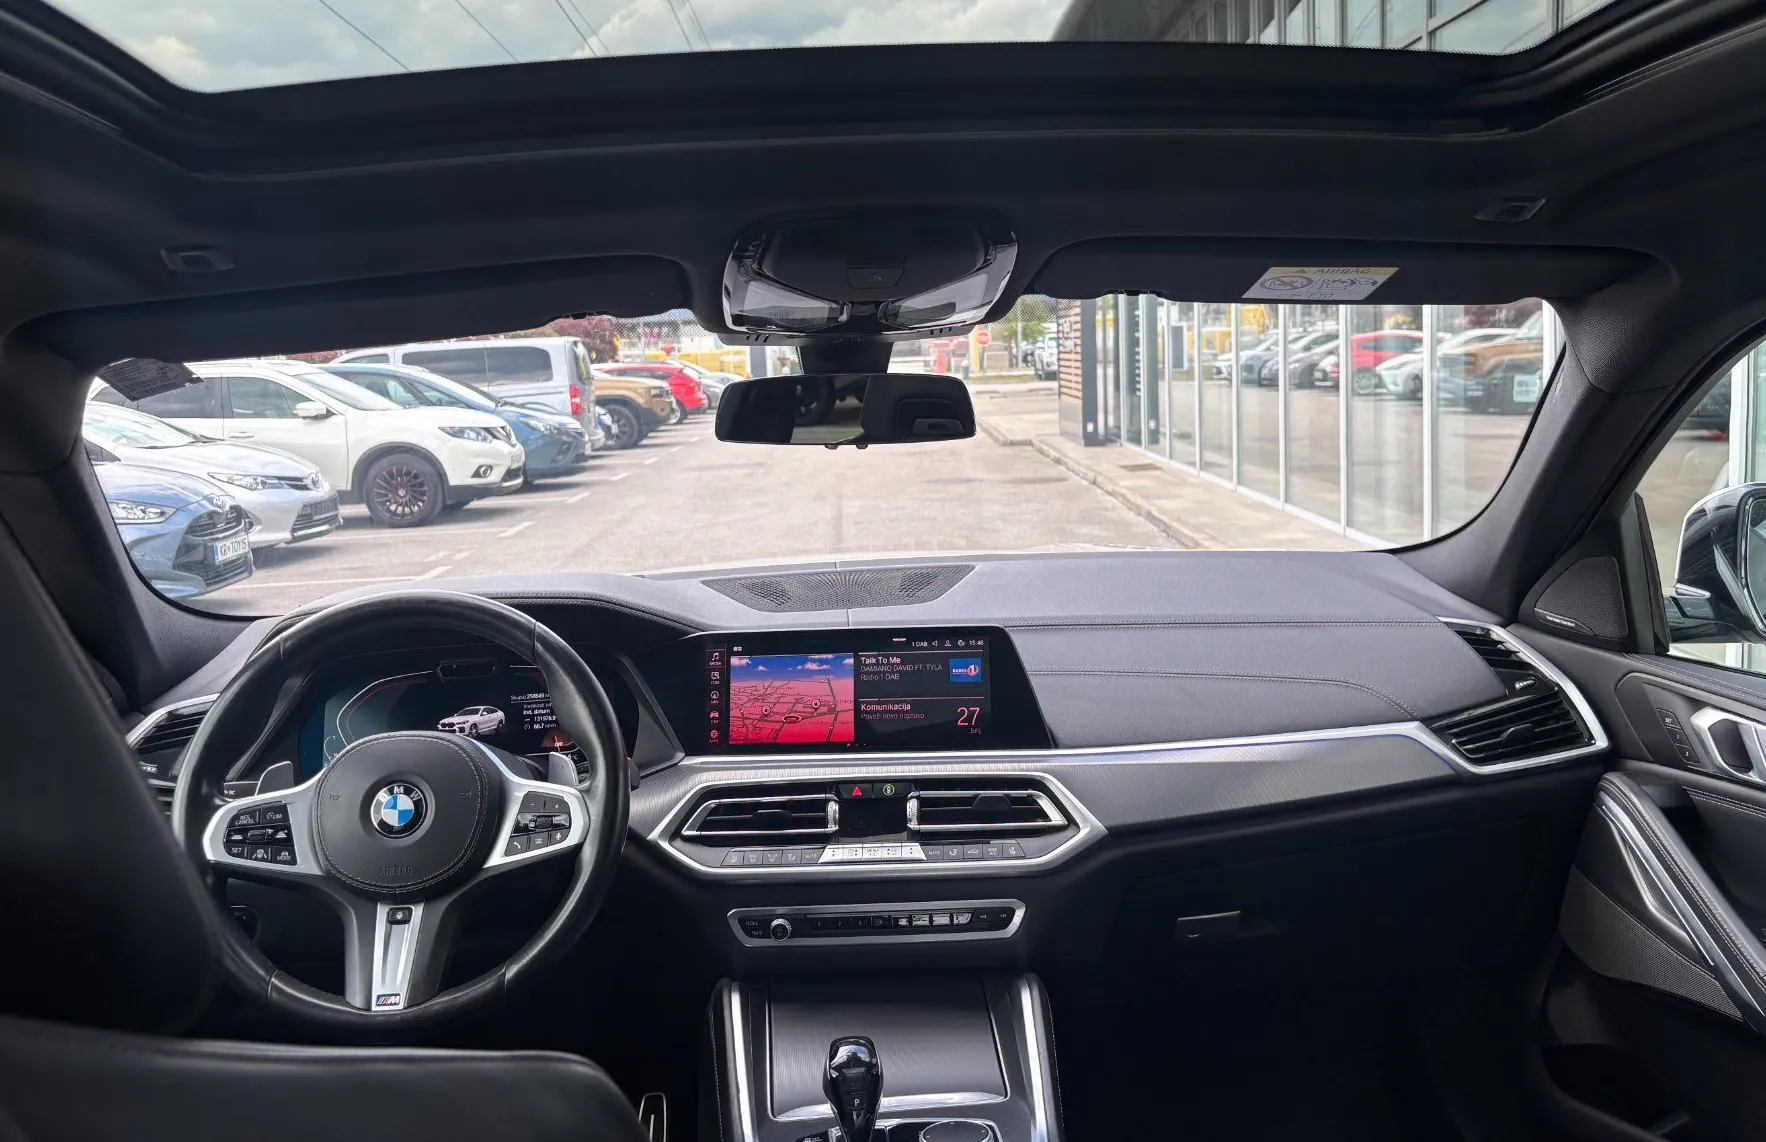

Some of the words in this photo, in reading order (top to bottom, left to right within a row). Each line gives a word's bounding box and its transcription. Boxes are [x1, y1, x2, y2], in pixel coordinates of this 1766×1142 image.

[889, 656, 901, 664] Me
[893, 664, 914, 672] DAVID
[861, 703, 911, 711] Komunikacija
[957, 707, 980, 726] 27
[377, 785, 422, 803] BMW
[380, 865, 414, 877] AIRBAG
[854, 1098, 861, 1107] P
